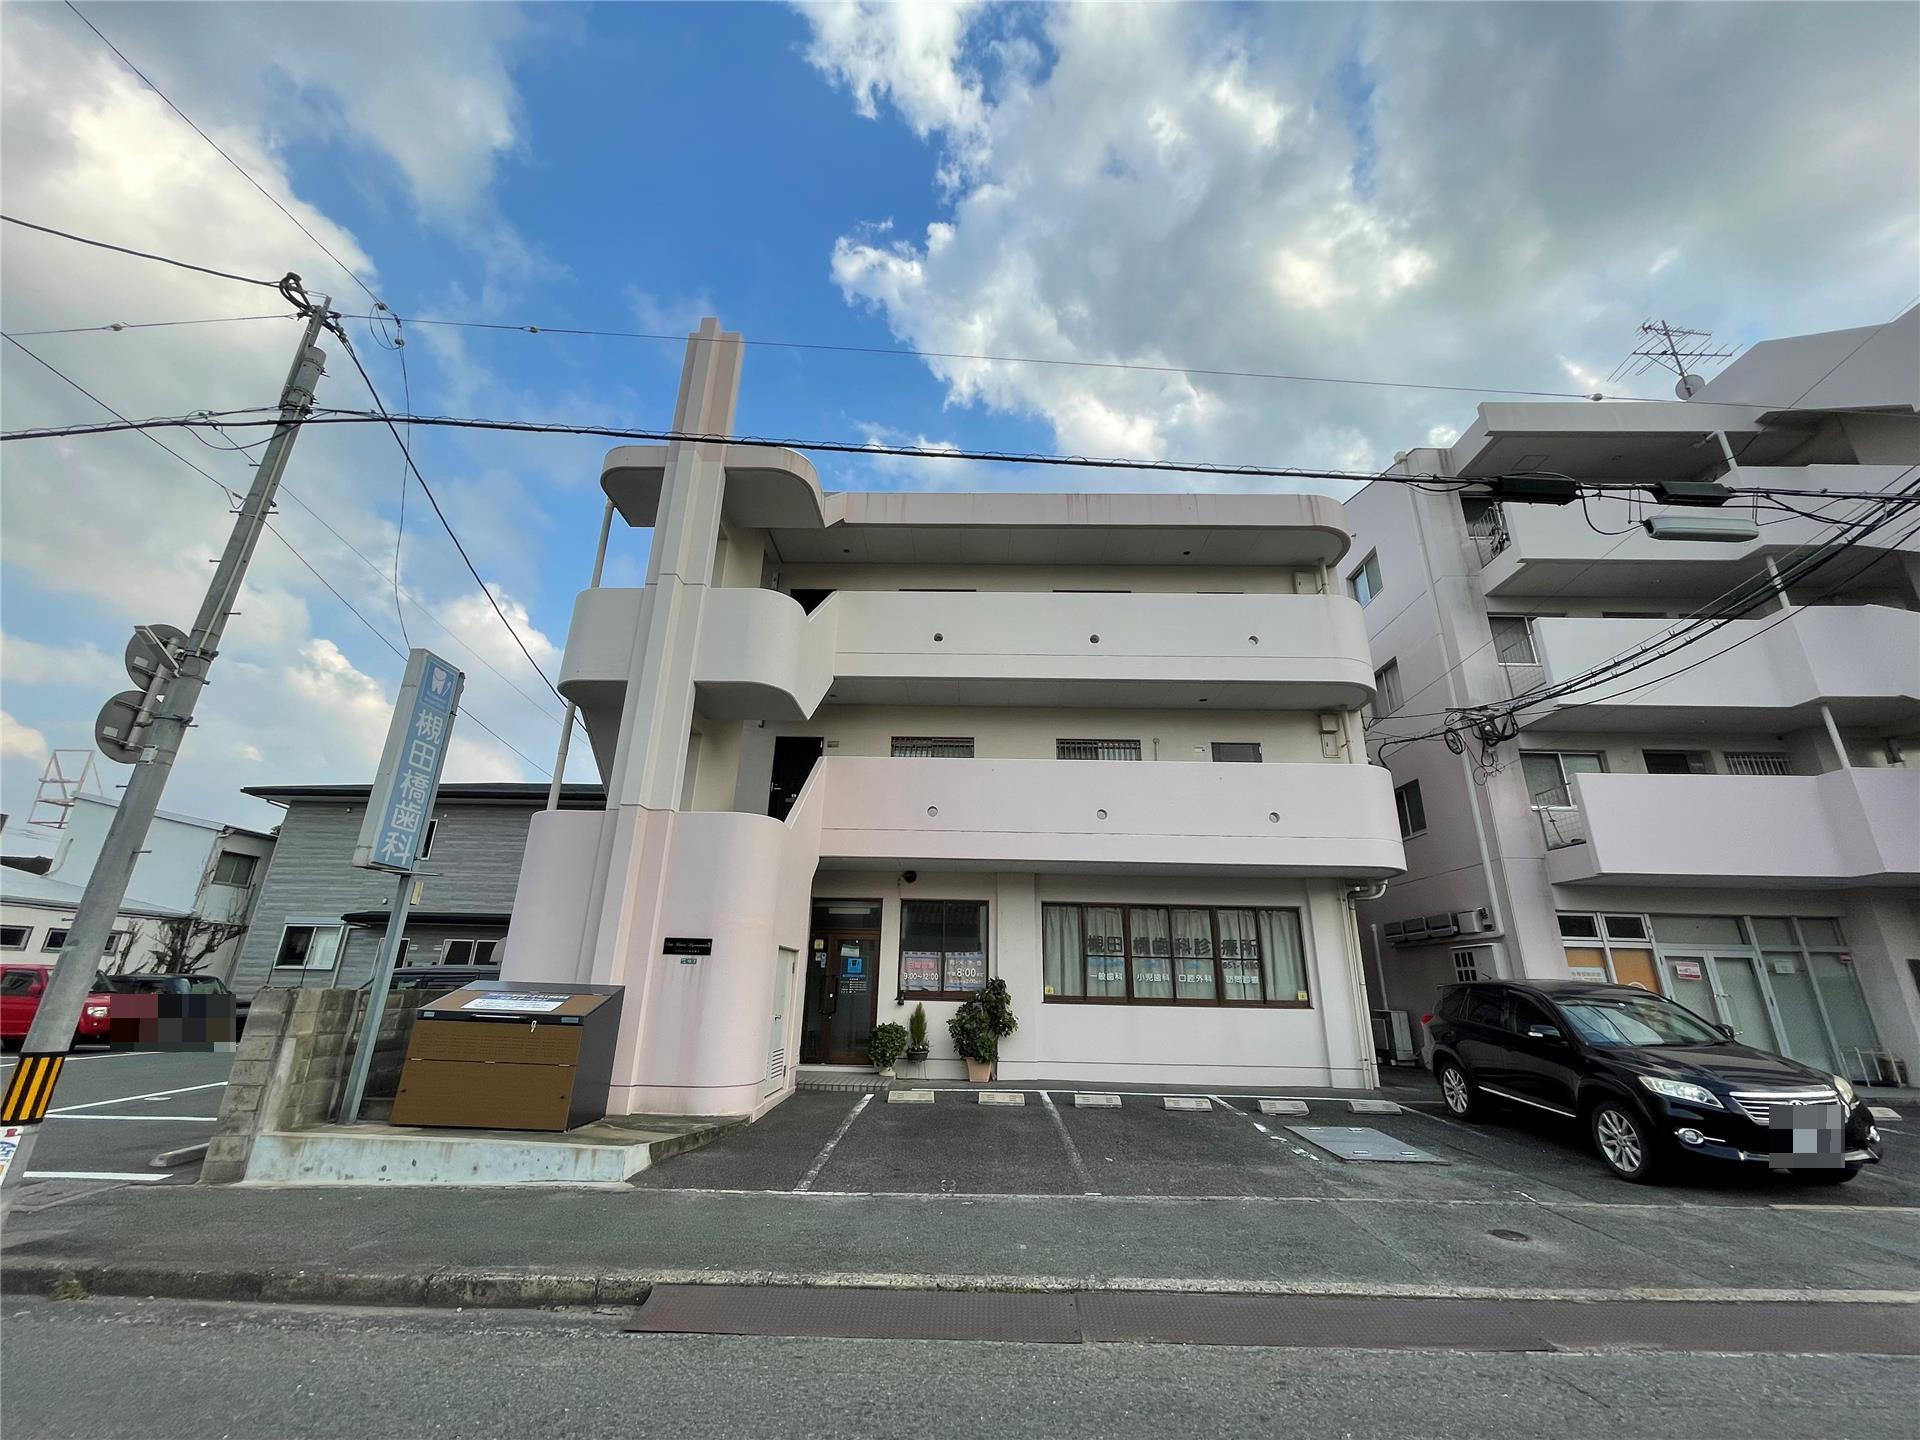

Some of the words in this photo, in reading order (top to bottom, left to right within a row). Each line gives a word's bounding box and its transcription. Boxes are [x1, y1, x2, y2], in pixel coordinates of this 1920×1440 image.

[382, 709, 443, 865] 槻田橋歯科
[1136, 973, 1170, 982] 小児歯科
